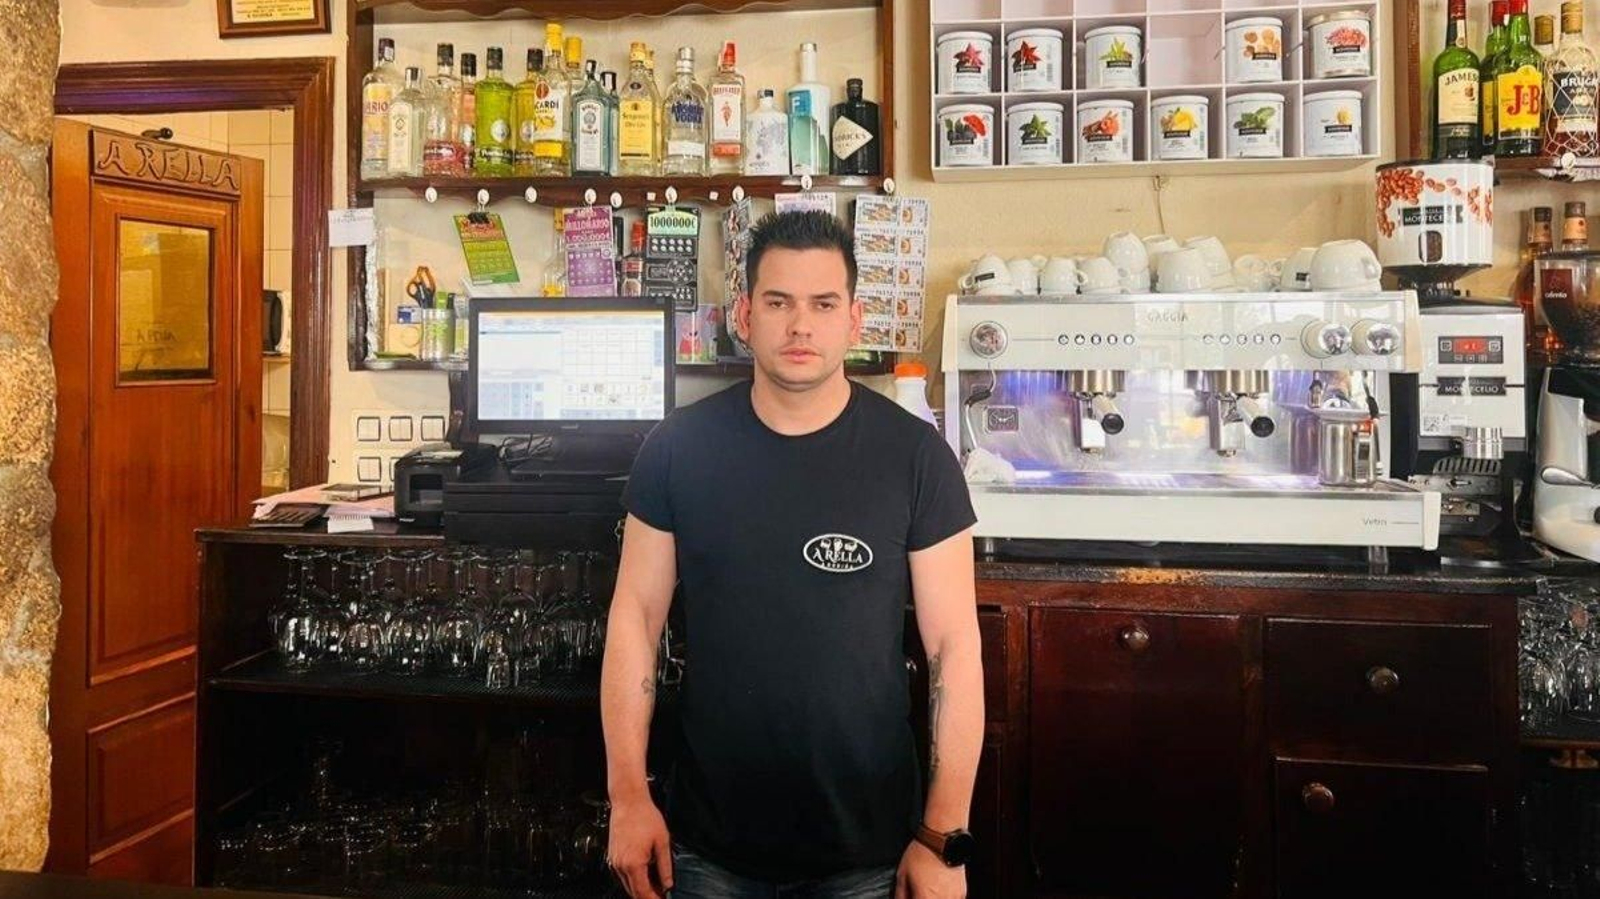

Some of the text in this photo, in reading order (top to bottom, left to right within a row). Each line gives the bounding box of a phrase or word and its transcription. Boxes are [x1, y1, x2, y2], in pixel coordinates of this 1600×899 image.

[98, 141, 238, 189] A RELLA
[812, 547, 863, 563] A RELLA
